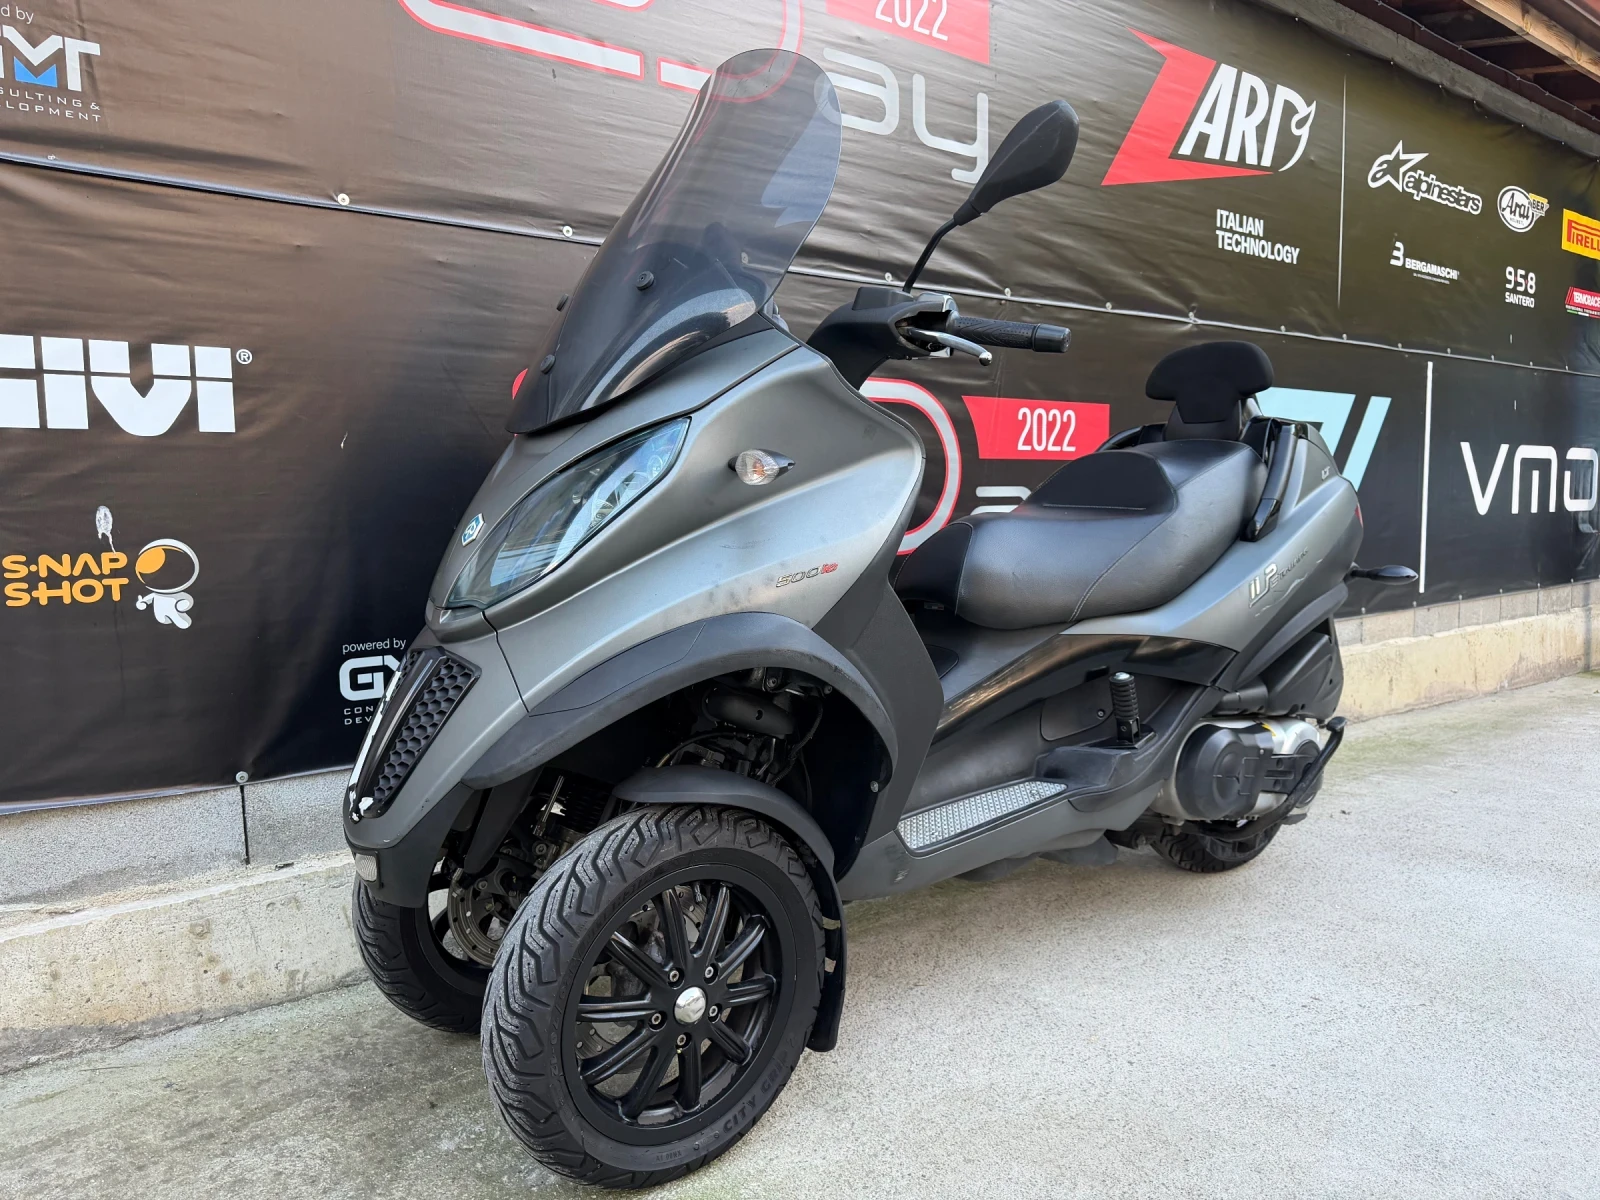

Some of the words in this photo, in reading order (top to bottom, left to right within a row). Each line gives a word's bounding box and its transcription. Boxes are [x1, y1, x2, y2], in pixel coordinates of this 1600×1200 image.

[15, 6, 34, 24] by
[0, 24, 101, 92] MT
[0, 100, 101, 122] LOPMENT
[1403, 169, 1483, 215] alpinestars
[1216, 208, 1264, 237] ITALIAN
[1215, 229, 1300, 265] TECHNOLOGY
[1404, 257, 1459, 280] BERGAMASCHI
[1504, 291, 1535, 309] SANTERO
[1017, 407, 1077, 452] 2022
[3, 577, 130, 607] SHOT
[342, 638, 390, 655] powered
[392, 637, 407, 650] by
